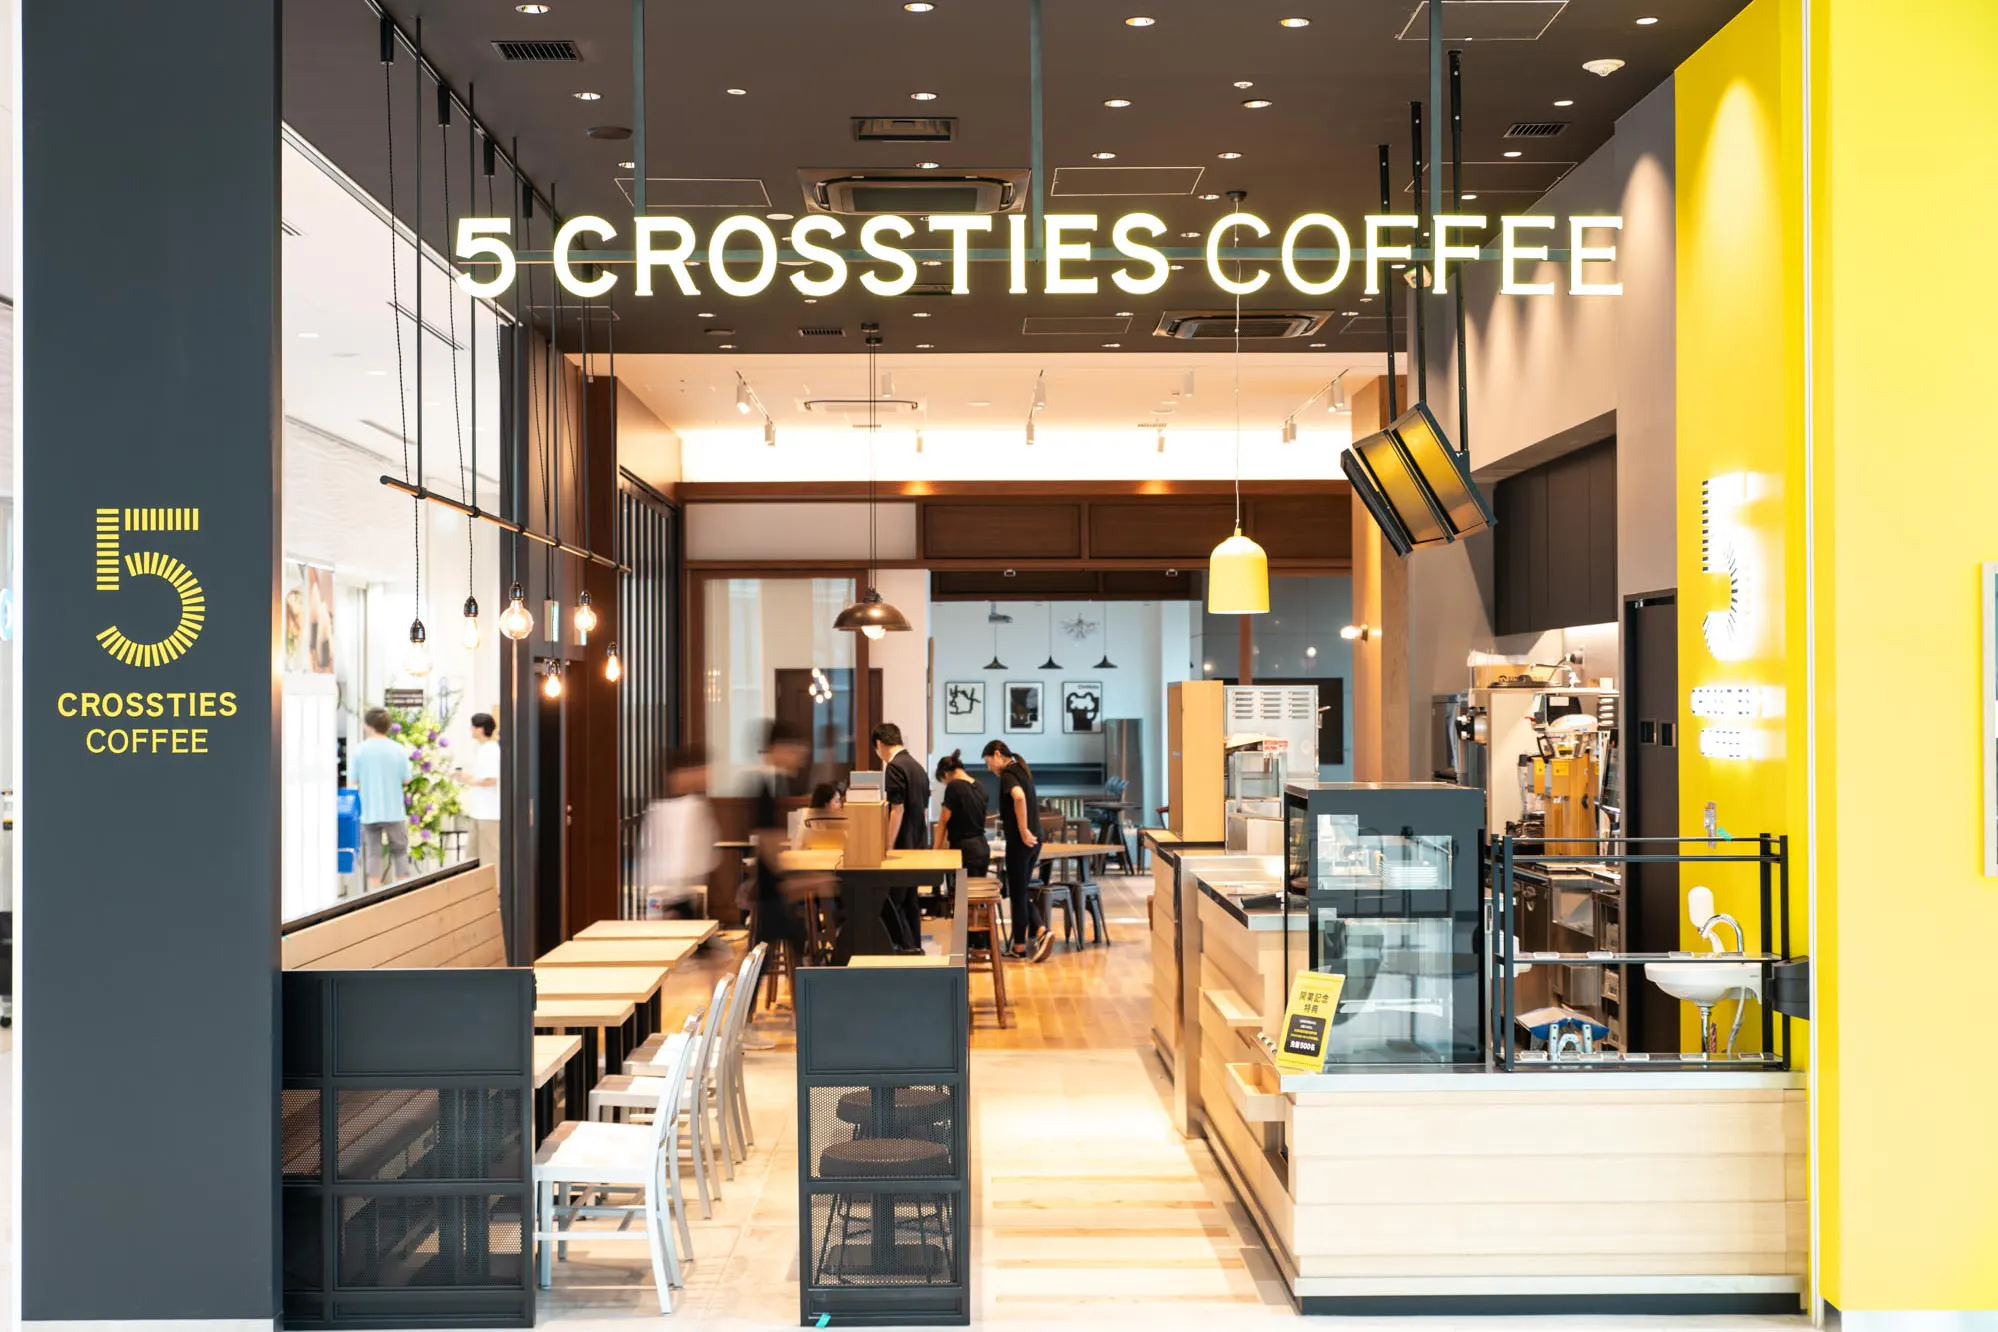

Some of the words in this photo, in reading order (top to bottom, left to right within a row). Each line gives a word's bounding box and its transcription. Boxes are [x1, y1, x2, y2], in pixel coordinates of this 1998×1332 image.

[454, 216, 518, 299] 5
[553, 213, 1170, 298] CROSSTIES
[1206, 213, 1625, 297] COFFEE
[96, 508, 206, 668] 5
[57, 691, 238, 718] CROSSTIES
[85, 728, 209, 754] COFFEE
